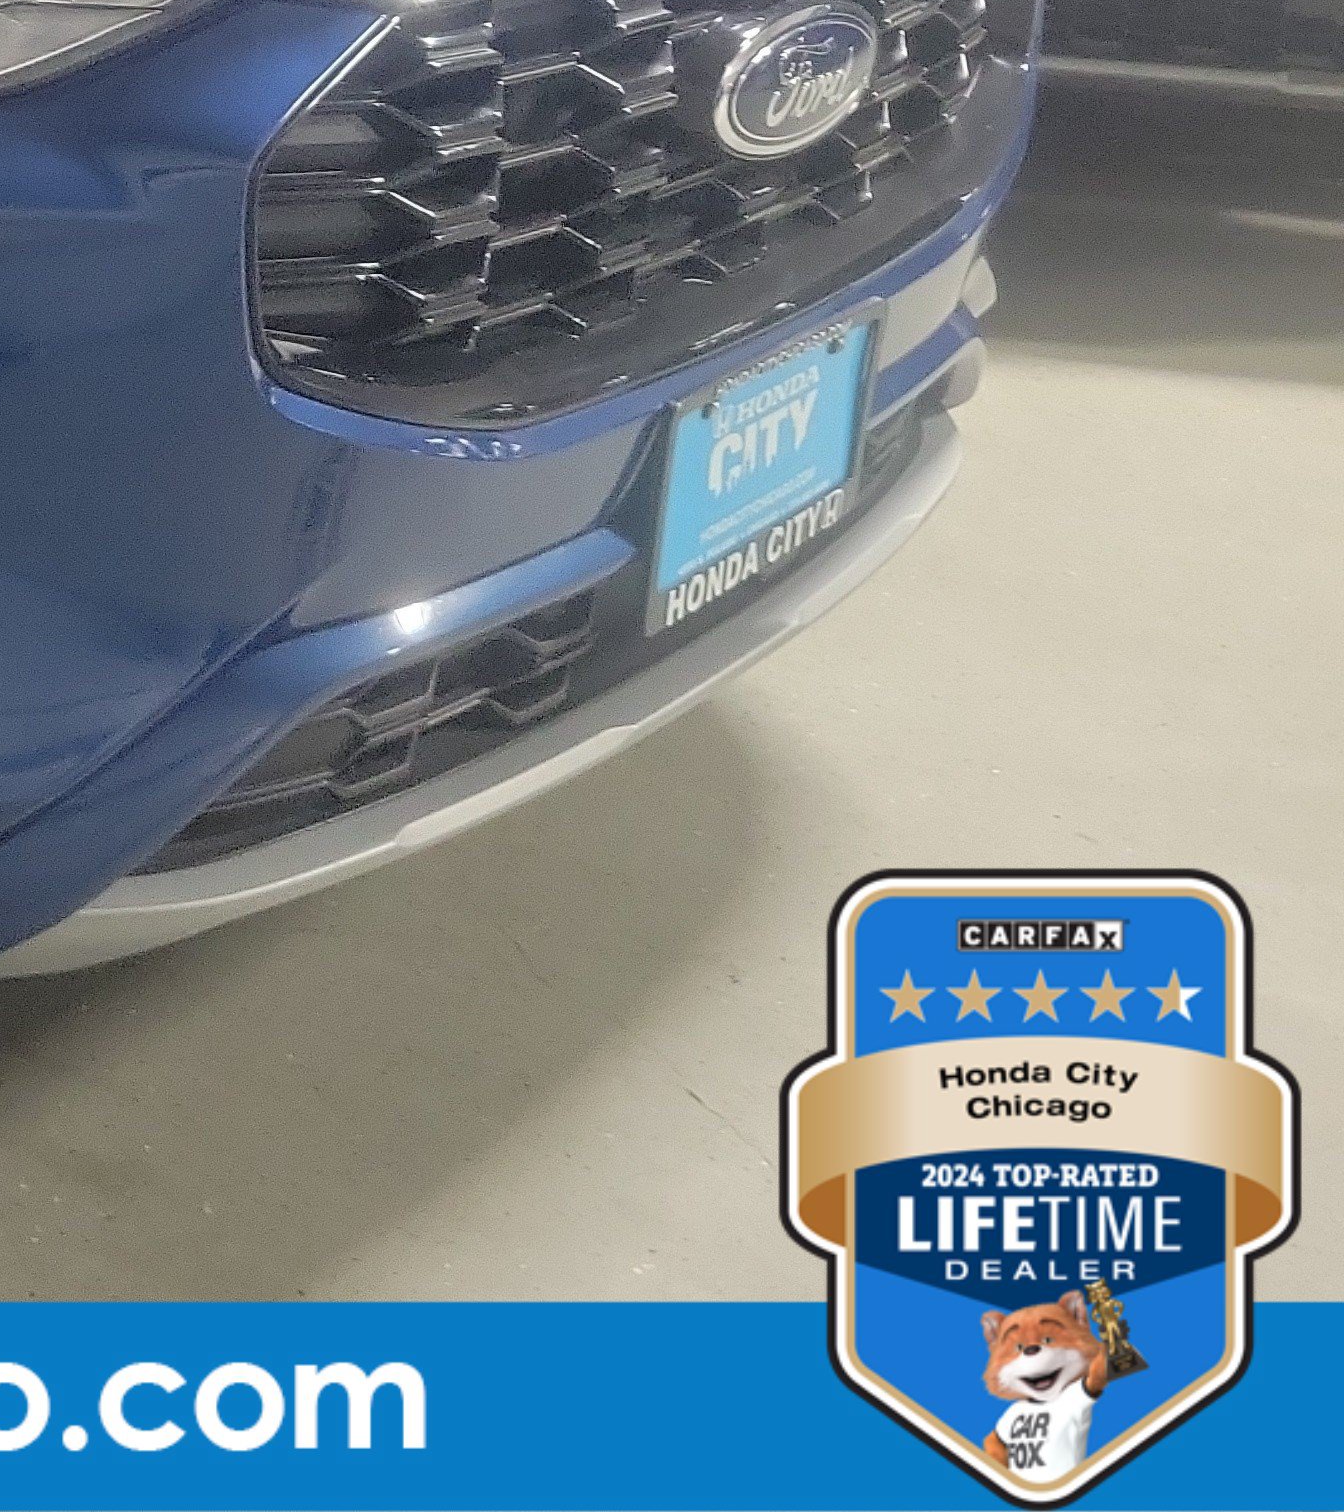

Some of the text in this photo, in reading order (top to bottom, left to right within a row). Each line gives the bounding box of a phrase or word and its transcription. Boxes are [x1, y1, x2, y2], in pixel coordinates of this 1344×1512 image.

[768, 40, 856, 127] Ford
[709, 387, 820, 498] CITY
[737, 365, 820, 423] HONDA
[665, 541, 760, 626] HONDA
[765, 501, 826, 564] CITY
